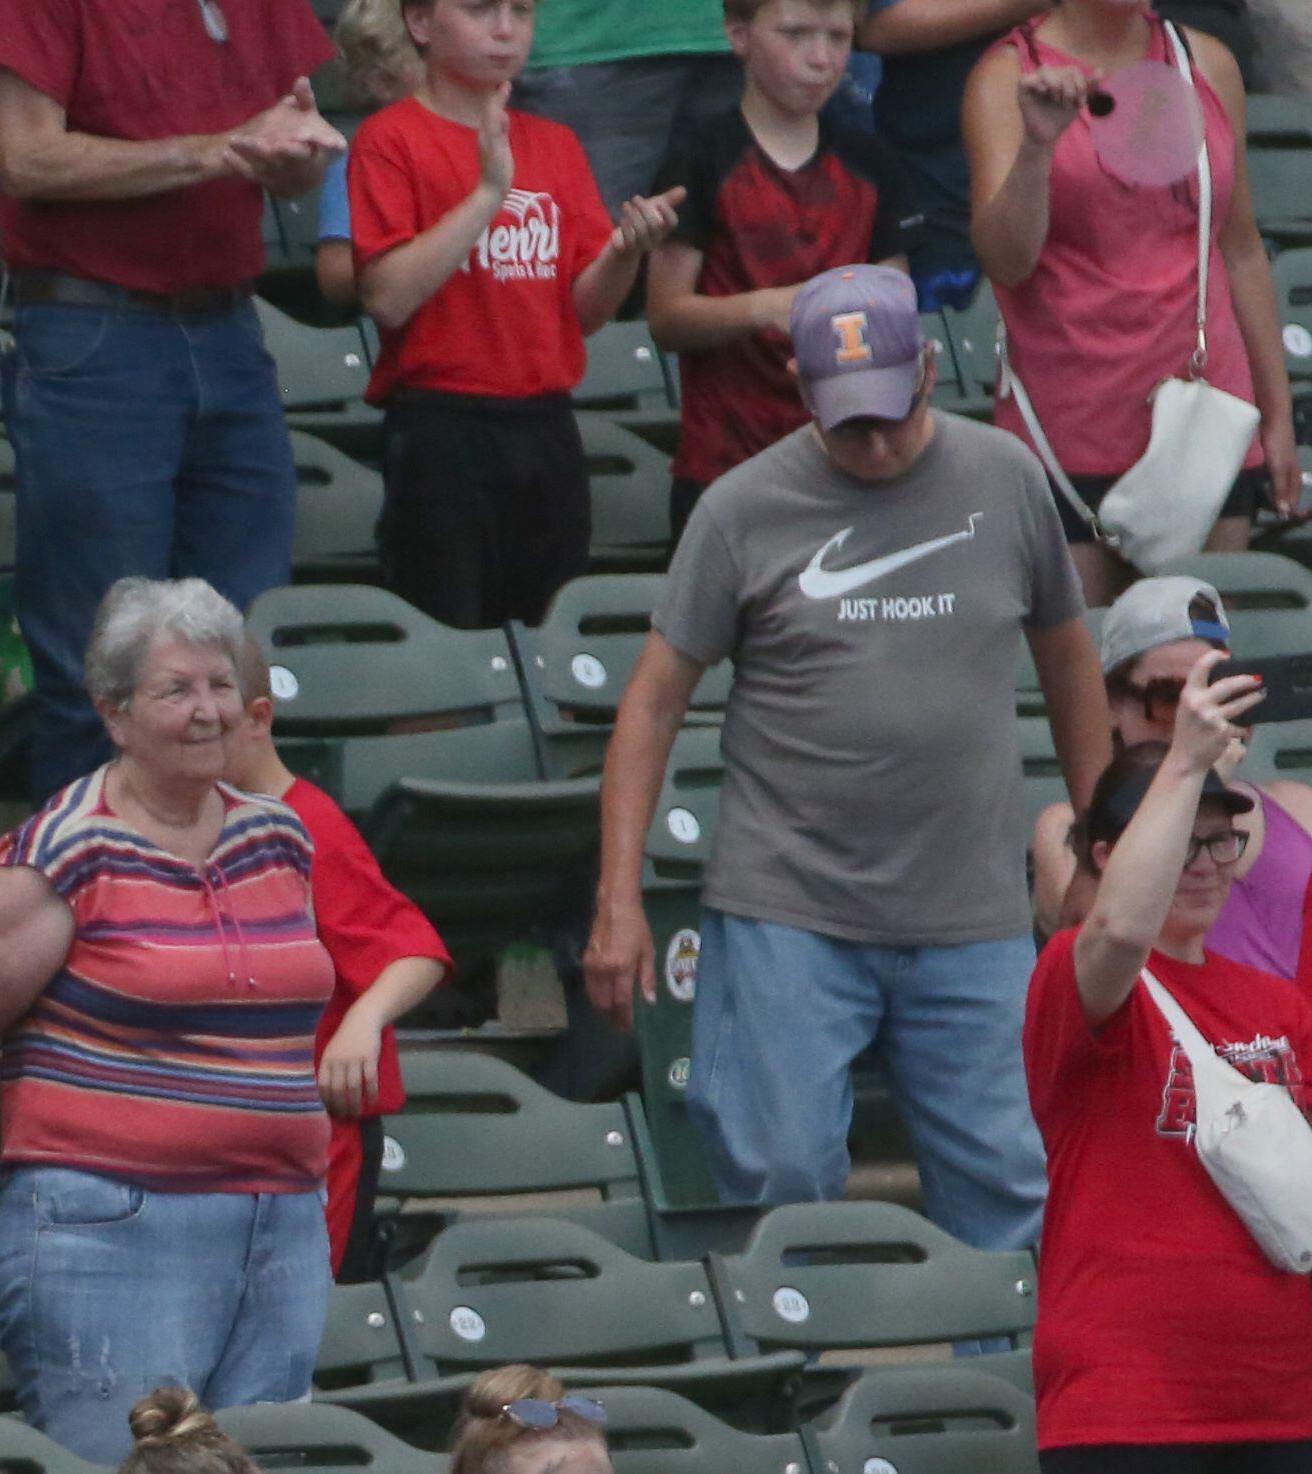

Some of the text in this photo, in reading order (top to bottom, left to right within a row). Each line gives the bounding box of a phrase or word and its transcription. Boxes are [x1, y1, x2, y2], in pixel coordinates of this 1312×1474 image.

[832, 311, 873, 364] I
[837, 593, 956, 621] JUST HOOK IT
